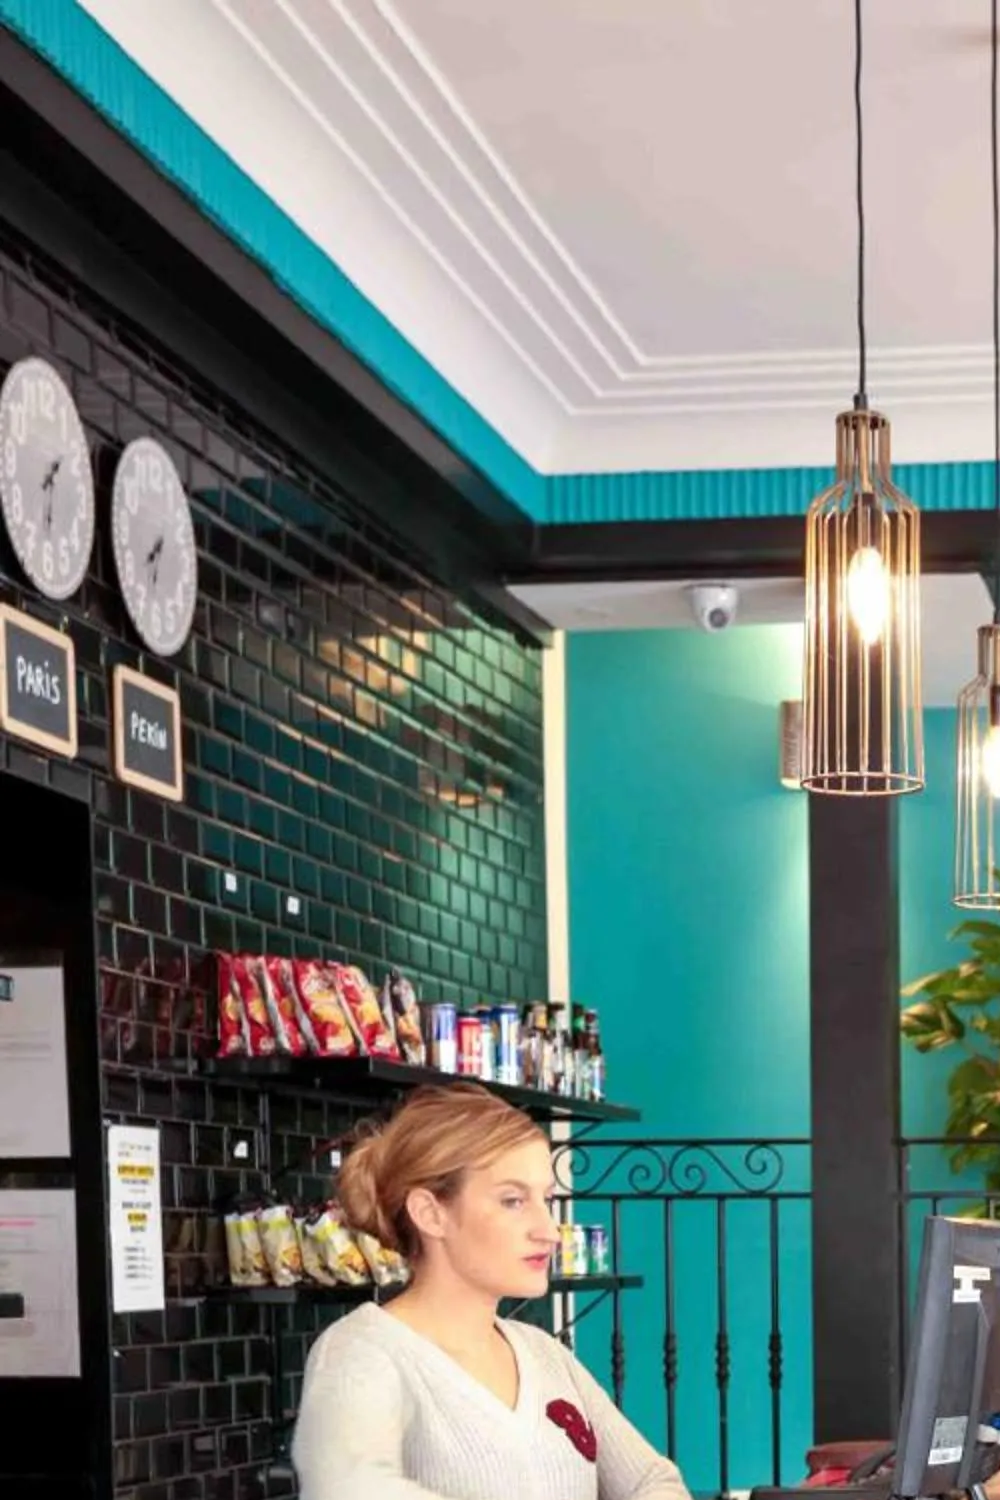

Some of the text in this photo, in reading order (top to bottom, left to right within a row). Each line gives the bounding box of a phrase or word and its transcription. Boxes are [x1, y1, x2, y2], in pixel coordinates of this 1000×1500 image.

[22, 377, 37, 418] 11
[38, 379, 56, 422] 12
[9, 402, 28, 445] 10
[60, 405, 68, 443] 1
[5, 437, 17, 478] 9
[70, 440, 82, 477] 2
[149, 455, 163, 494] 12
[12, 482, 24, 524] 8
[76, 483, 87, 521] 3
[25, 521, 38, 558] 7
[69, 517, 80, 554] 4
[42, 541, 54, 580] 6
[58, 537, 70, 576] 5
[135, 583, 147, 617] 7
[150, 599, 162, 640] 6
[165, 597, 176, 634] 5
